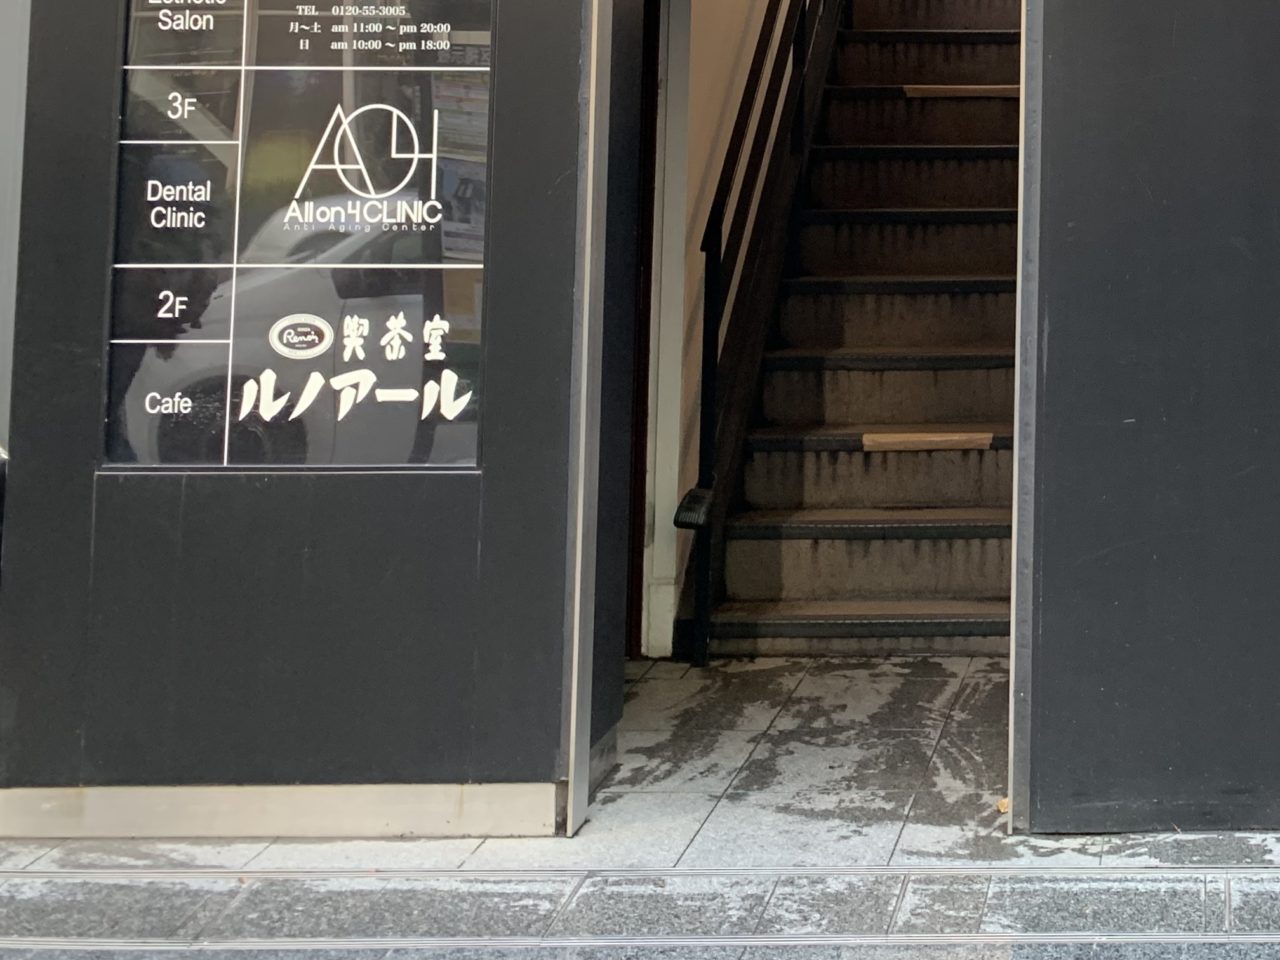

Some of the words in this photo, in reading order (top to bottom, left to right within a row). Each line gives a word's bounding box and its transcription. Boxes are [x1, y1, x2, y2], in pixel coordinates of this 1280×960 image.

[158, 10, 214, 31] Salon
[296, 5, 319, 16] TEL
[331, 5, 406, 16] 0120-55-3005
[331, 25, 349, 33] am
[352, 23, 382, 33] 11:00
[399, 25, 417, 35] pm
[420, 23, 451, 33] 20:00
[330, 42, 348, 50] am
[352, 40, 382, 50] 10:00
[399, 42, 417, 52] pm
[420, 40, 450, 50] 18:00
[167, 92, 196, 119] 3F
[147, 180, 211, 202] Dental
[150, 207, 206, 228] Clinic
[283, 223, 316, 231] Anti
[328, 223, 371, 233] Aging
[157, 291, 188, 319] 2F
[342, 310, 450, 362] 喫茶室
[145, 392, 192, 415] Cafe
[238, 368, 473, 422] ルノアール
